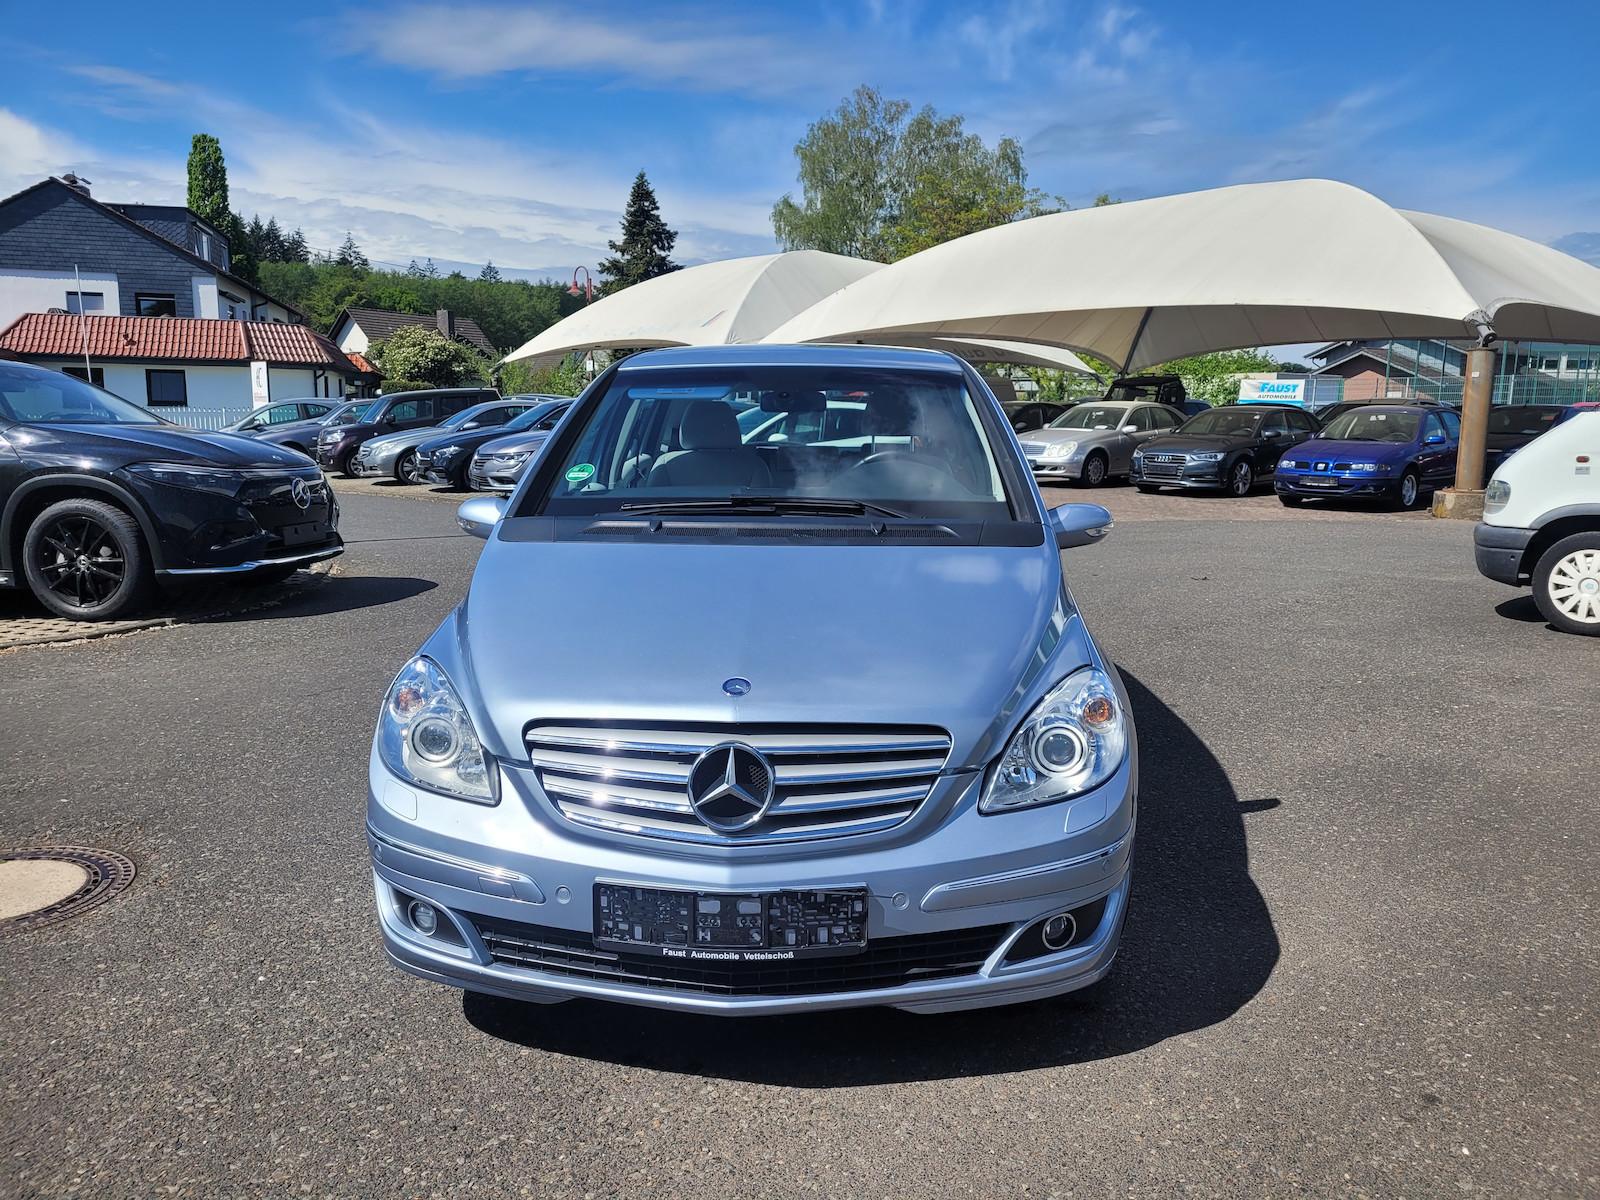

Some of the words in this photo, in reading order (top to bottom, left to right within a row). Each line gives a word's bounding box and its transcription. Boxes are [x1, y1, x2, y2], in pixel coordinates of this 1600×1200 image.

[1259, 382, 1299, 393] FAUST
[662, 947, 687, 958] Faust
[690, 950, 740, 960] Automobile
[743, 951, 795, 961] Vettelschoß
